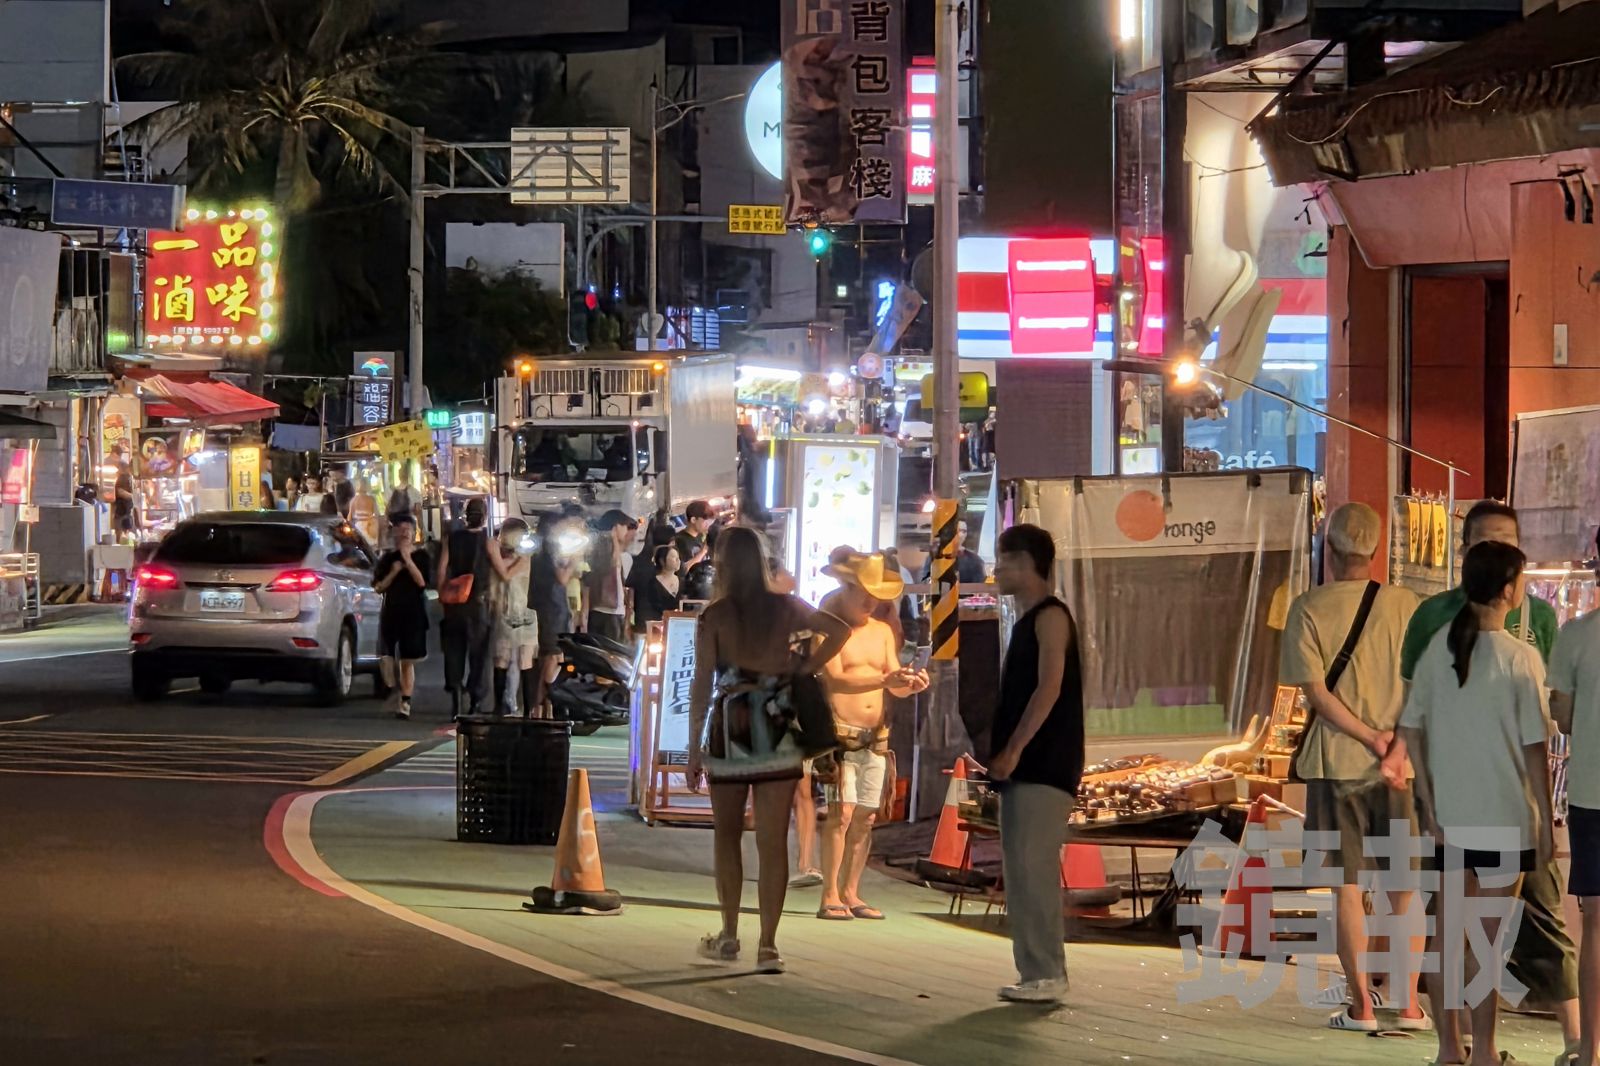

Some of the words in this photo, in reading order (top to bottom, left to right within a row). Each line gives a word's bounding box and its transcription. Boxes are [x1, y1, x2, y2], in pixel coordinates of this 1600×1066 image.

[850, 1, 892, 199] 背包客棧
[153, 222, 257, 268] 一品
[154, 275, 257, 321] 滷味
